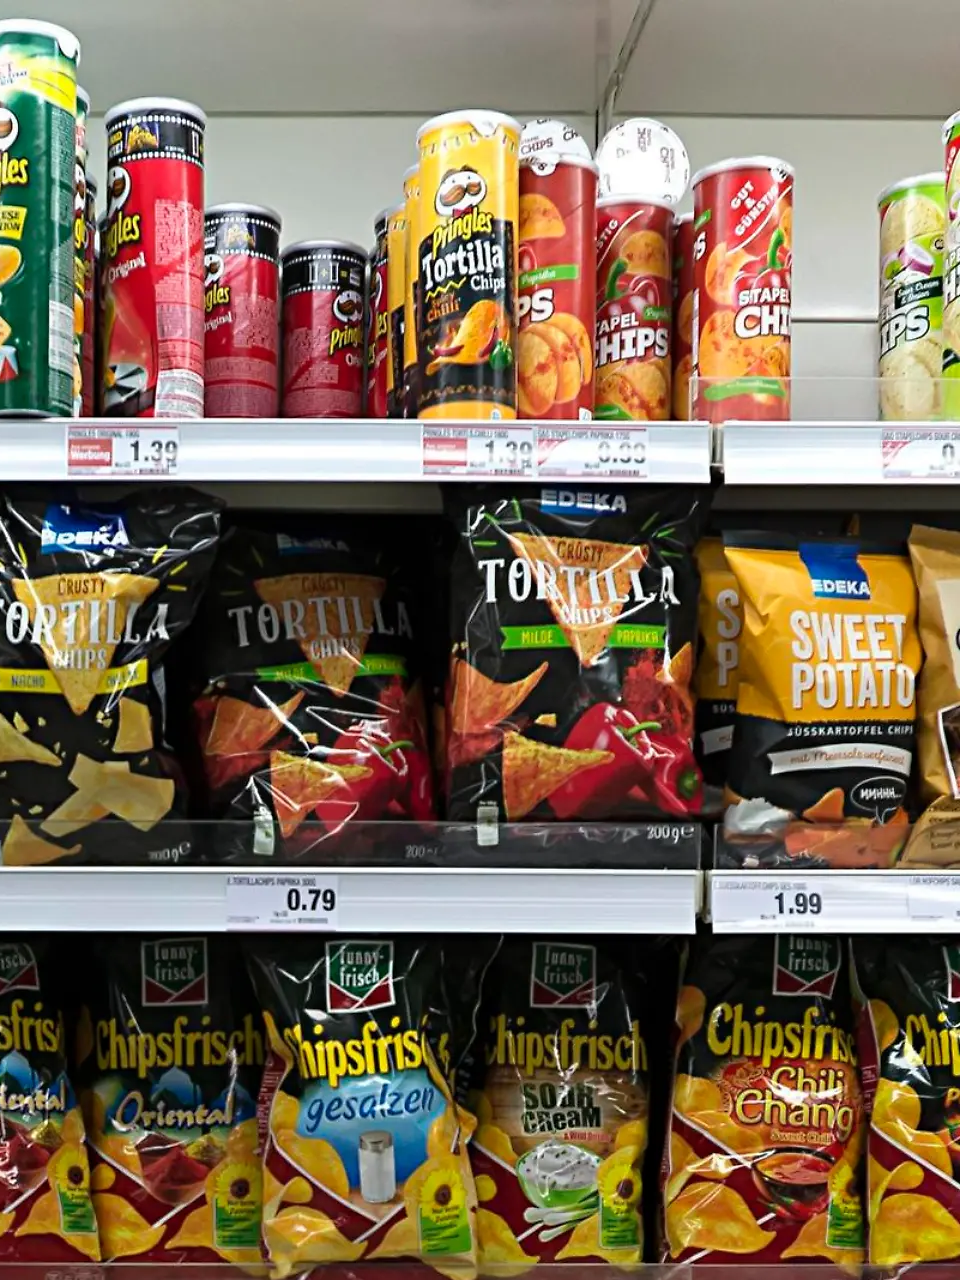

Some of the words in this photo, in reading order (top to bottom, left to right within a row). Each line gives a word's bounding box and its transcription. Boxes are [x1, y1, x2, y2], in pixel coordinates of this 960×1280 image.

[730, 181, 755, 211] GUT
[432, 206, 493, 259] Pringles
[422, 241, 505, 291] Tortilla
[470, 275, 505, 293] Chips
[130, 439, 178, 462] 1.39
[541, 489, 628, 513] EDEKA
[556, 540, 606, 561] CRUSTY
[58, 578, 107, 597] CRUSTY
[478, 558, 682, 606] TORTILLA
[812, 577, 871, 596] EDEKA
[228, 599, 415, 647] TORTILLA
[521, 630, 554, 645] MILDE
[617, 630, 660, 645] PAPRIKA
[789, 610, 907, 661] SWEET
[791, 663, 916, 710] POTATO
[287, 888, 336, 912] 0.79
[775, 892, 822, 915] 1.99
[788, 952, 830, 972] frisch
[340, 968, 381, 988] frisch
[543, 966, 584, 985] frisch
[95, 1013, 262, 1079] Chipsfrisch
[770, 1066, 846, 1099] Chili
[112, 1091, 234, 1132] Oriental
[306, 1083, 434, 1132] gesalzen
[736, 1090, 854, 1142] Chang
[771, 1129, 808, 1142] Sweet
